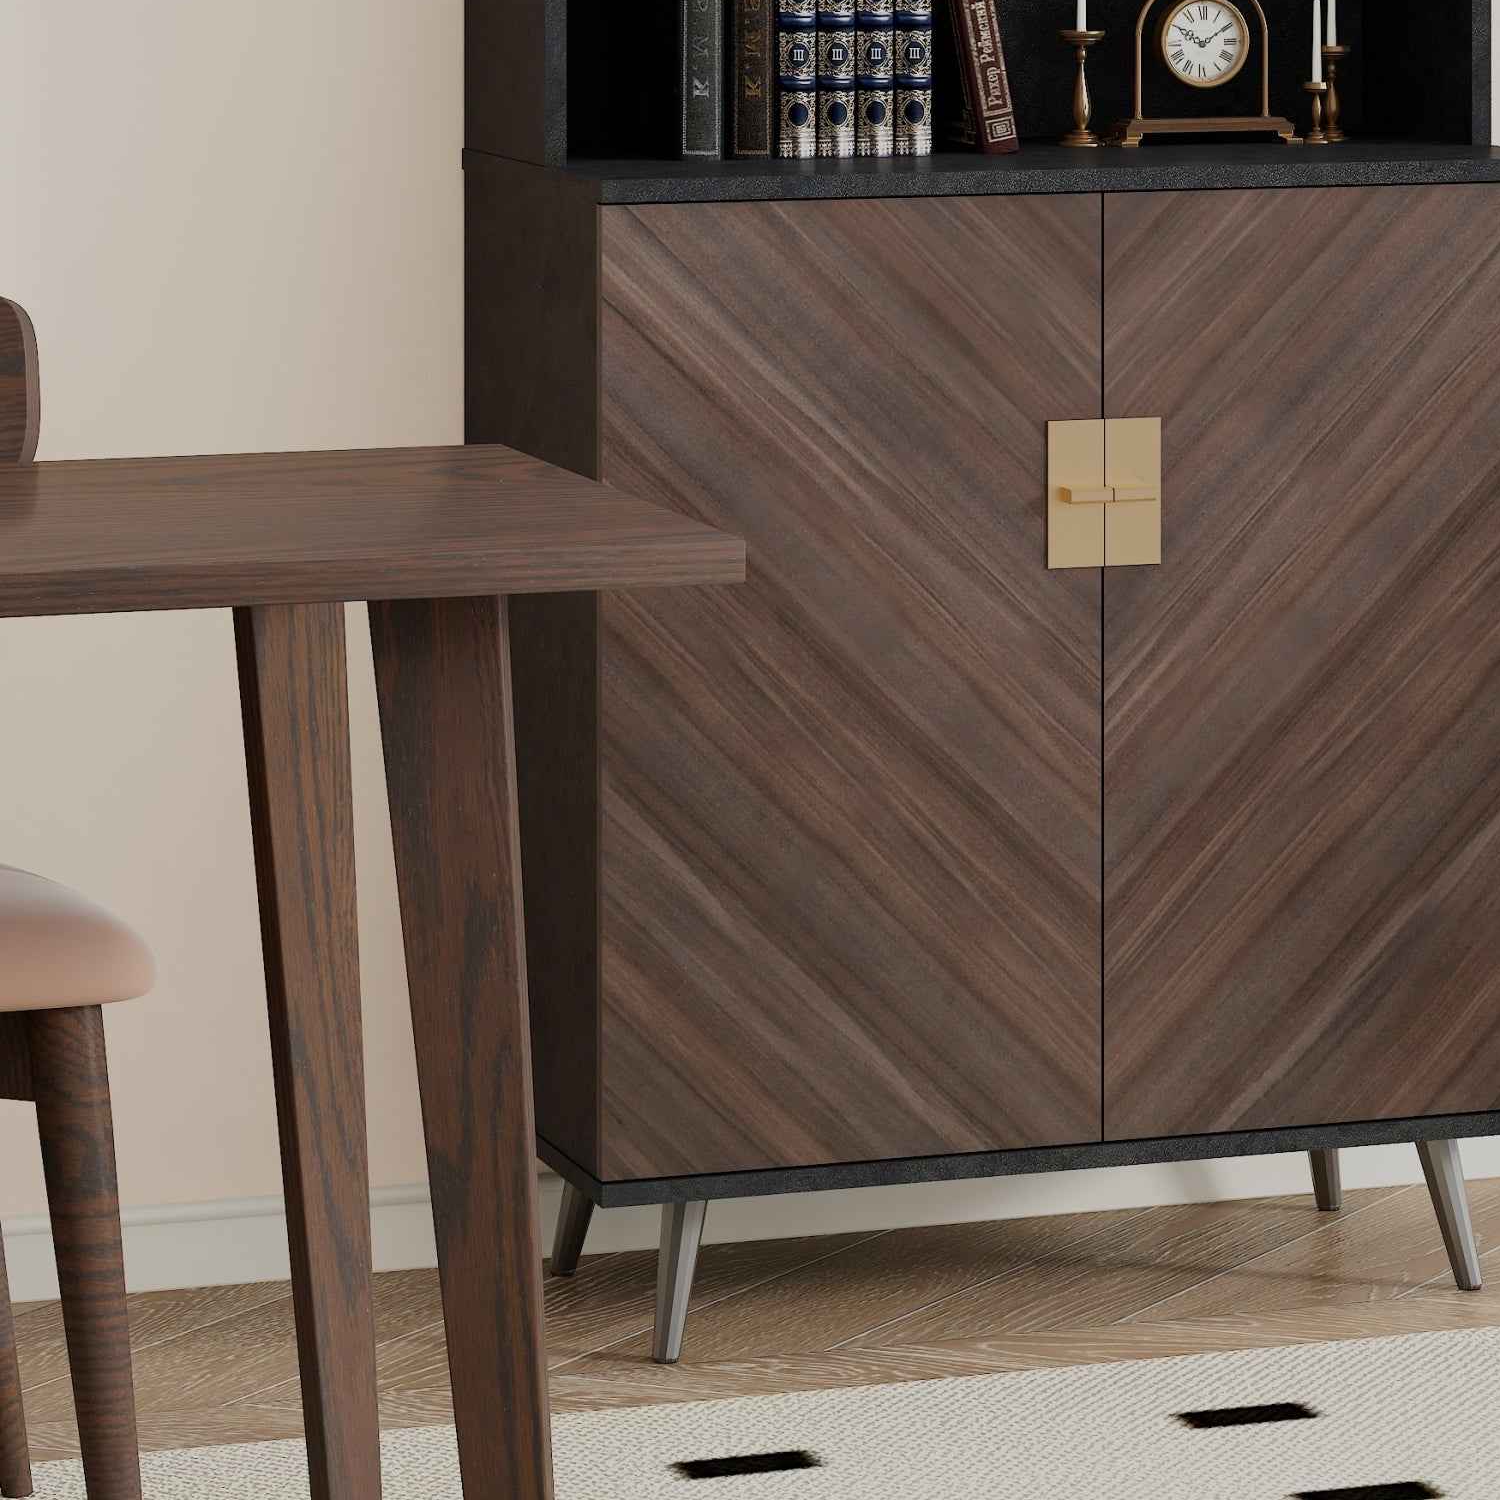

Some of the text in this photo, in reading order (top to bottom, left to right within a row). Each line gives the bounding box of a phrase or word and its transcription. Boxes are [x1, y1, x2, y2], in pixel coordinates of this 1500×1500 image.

[793, 49, 805, 62] III
[832, 48, 844, 61] III
[870, 47, 882, 60] III
[908, 47, 920, 60] III
